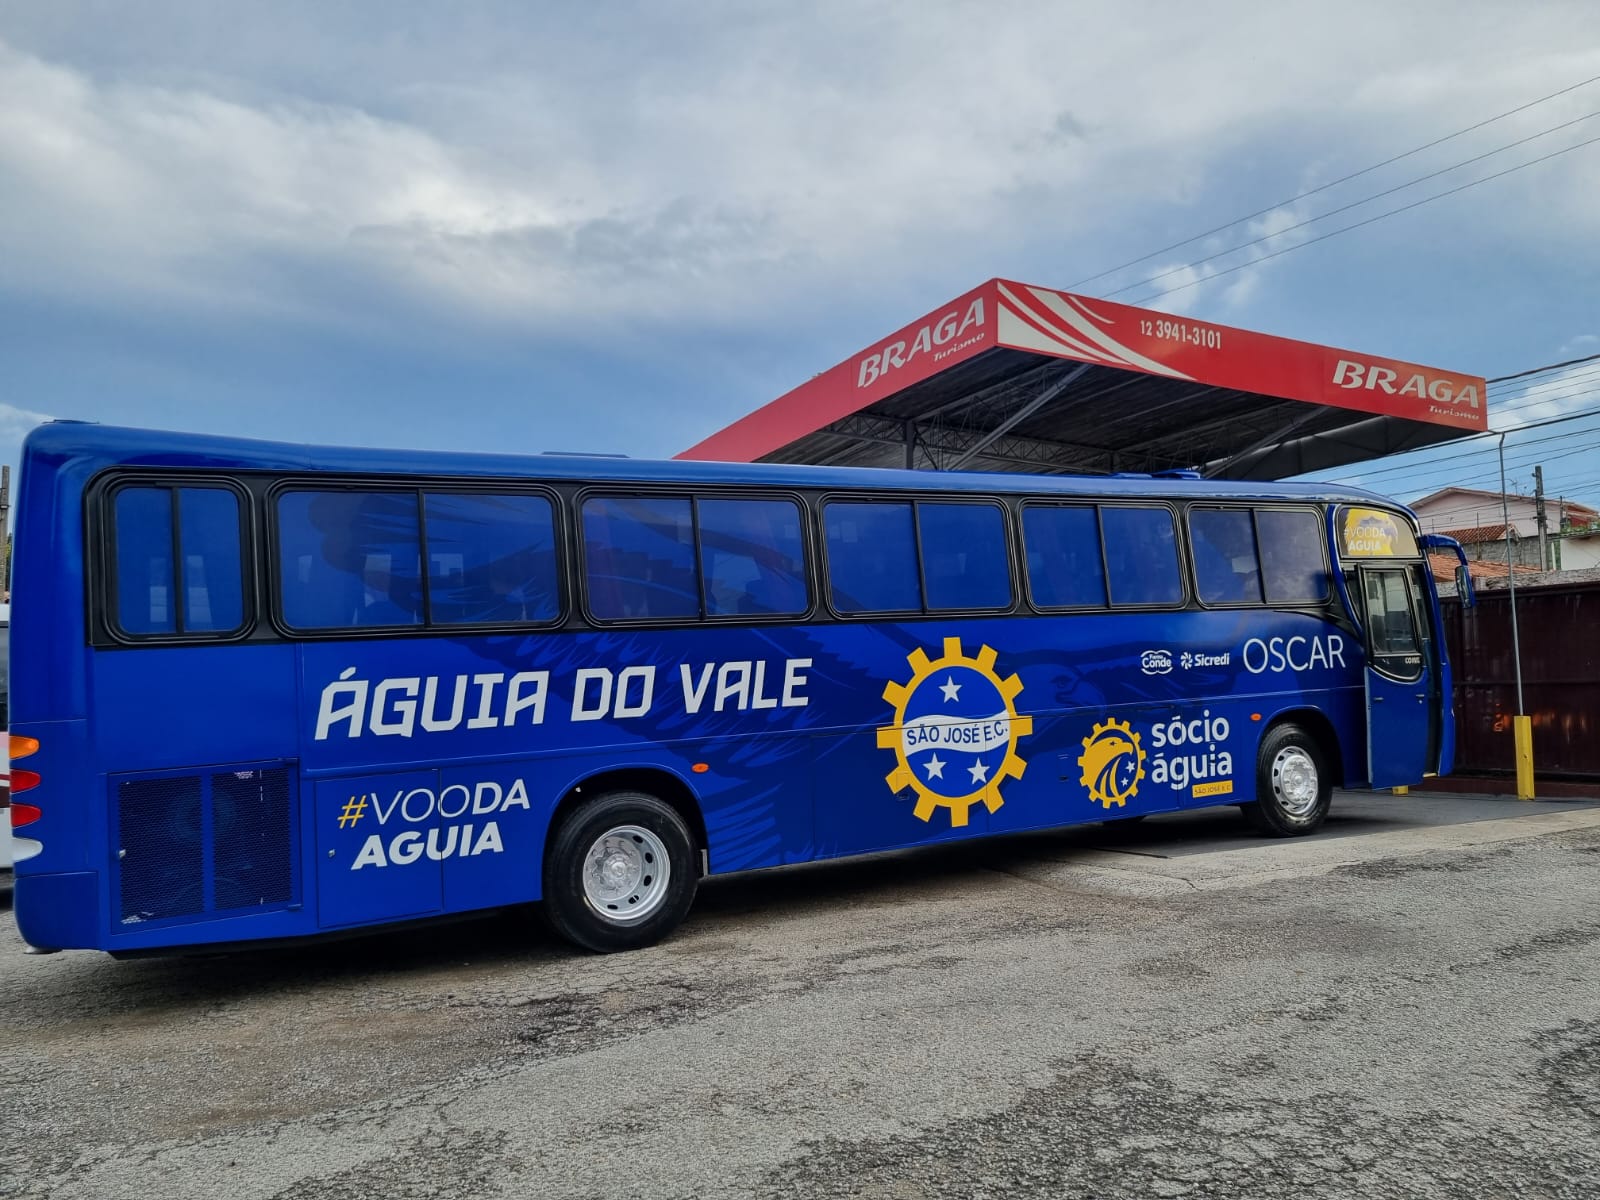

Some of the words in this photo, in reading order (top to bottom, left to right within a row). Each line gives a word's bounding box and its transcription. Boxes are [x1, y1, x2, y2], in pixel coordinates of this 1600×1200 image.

[857, 297, 985, 388] BRAGA
[933, 332, 985, 362] Turismo
[1140, 320, 1153, 337] 12
[1156, 320, 1222, 349] 3941-3101
[1332, 360, 1479, 408] BRAGA
[1142, 657, 1172, 668] Conde
[1194, 653, 1230, 667] Sicredi
[1243, 635, 1346, 674] OSCAR
[315, 666, 549, 740] ÁGUIA
[570, 666, 656, 721] DO
[680, 658, 812, 714] VALE
[907, 724, 940, 746] SÃO
[944, 724, 980, 743] JOSÉ
[1151, 709, 1230, 748] sócio
[1151, 743, 1233, 790] águia
[351, 822, 504, 871] AGUIA
